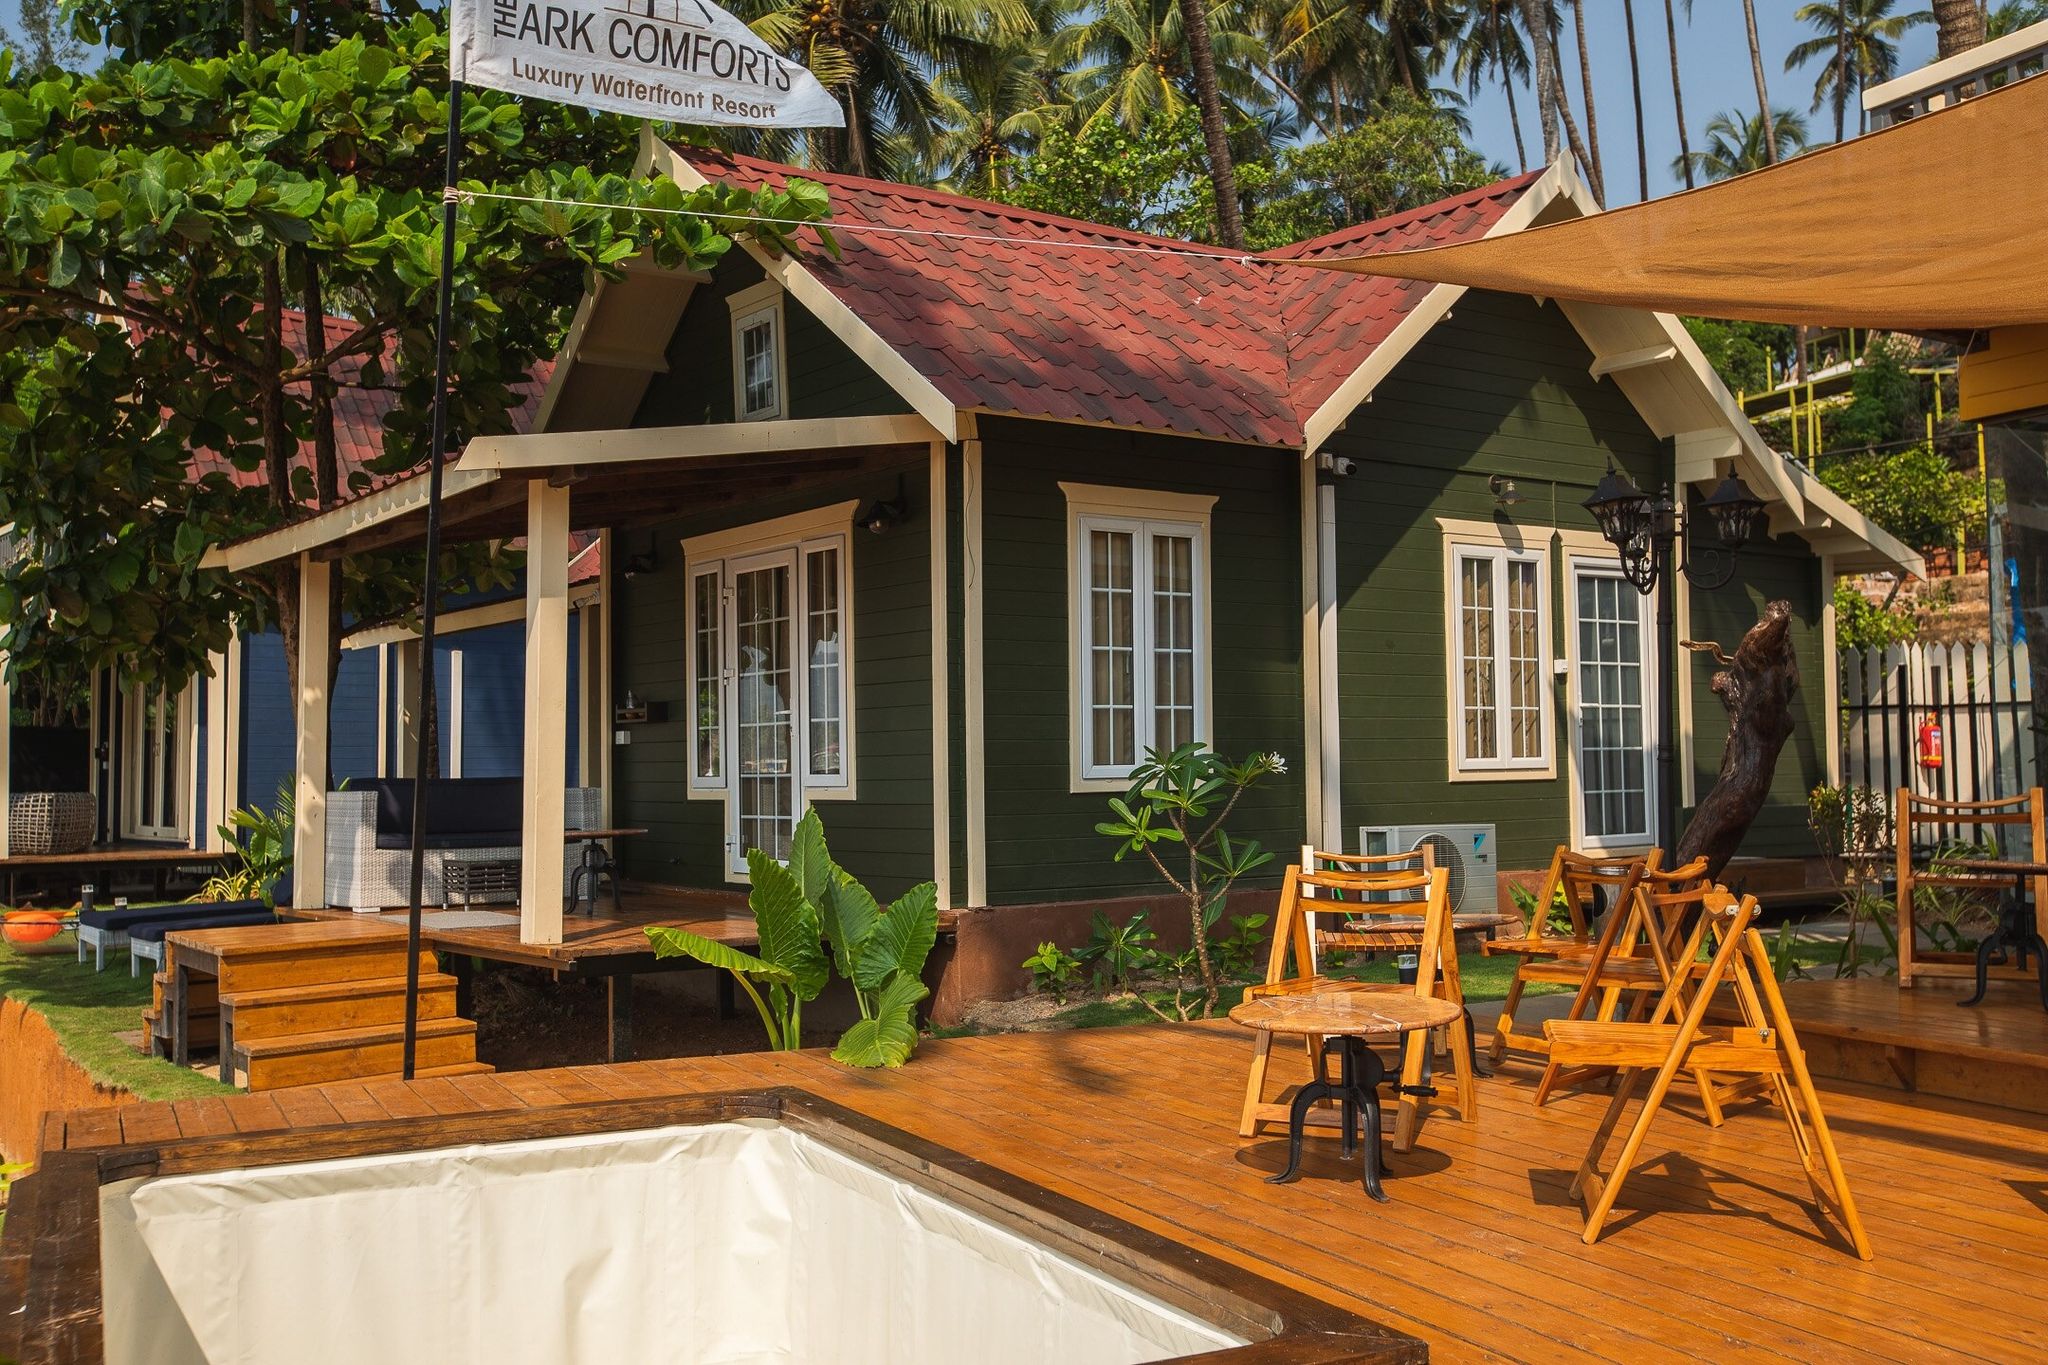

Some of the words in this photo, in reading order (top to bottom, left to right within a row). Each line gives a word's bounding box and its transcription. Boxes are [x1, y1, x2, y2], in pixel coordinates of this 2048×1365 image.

[518, 3, 596, 54] ARK
[608, 18, 791, 92] COMFORTS
[512, 57, 584, 95] Luxury
[592, 72, 704, 109] Waterfront
[712, 93, 776, 119] Resort
